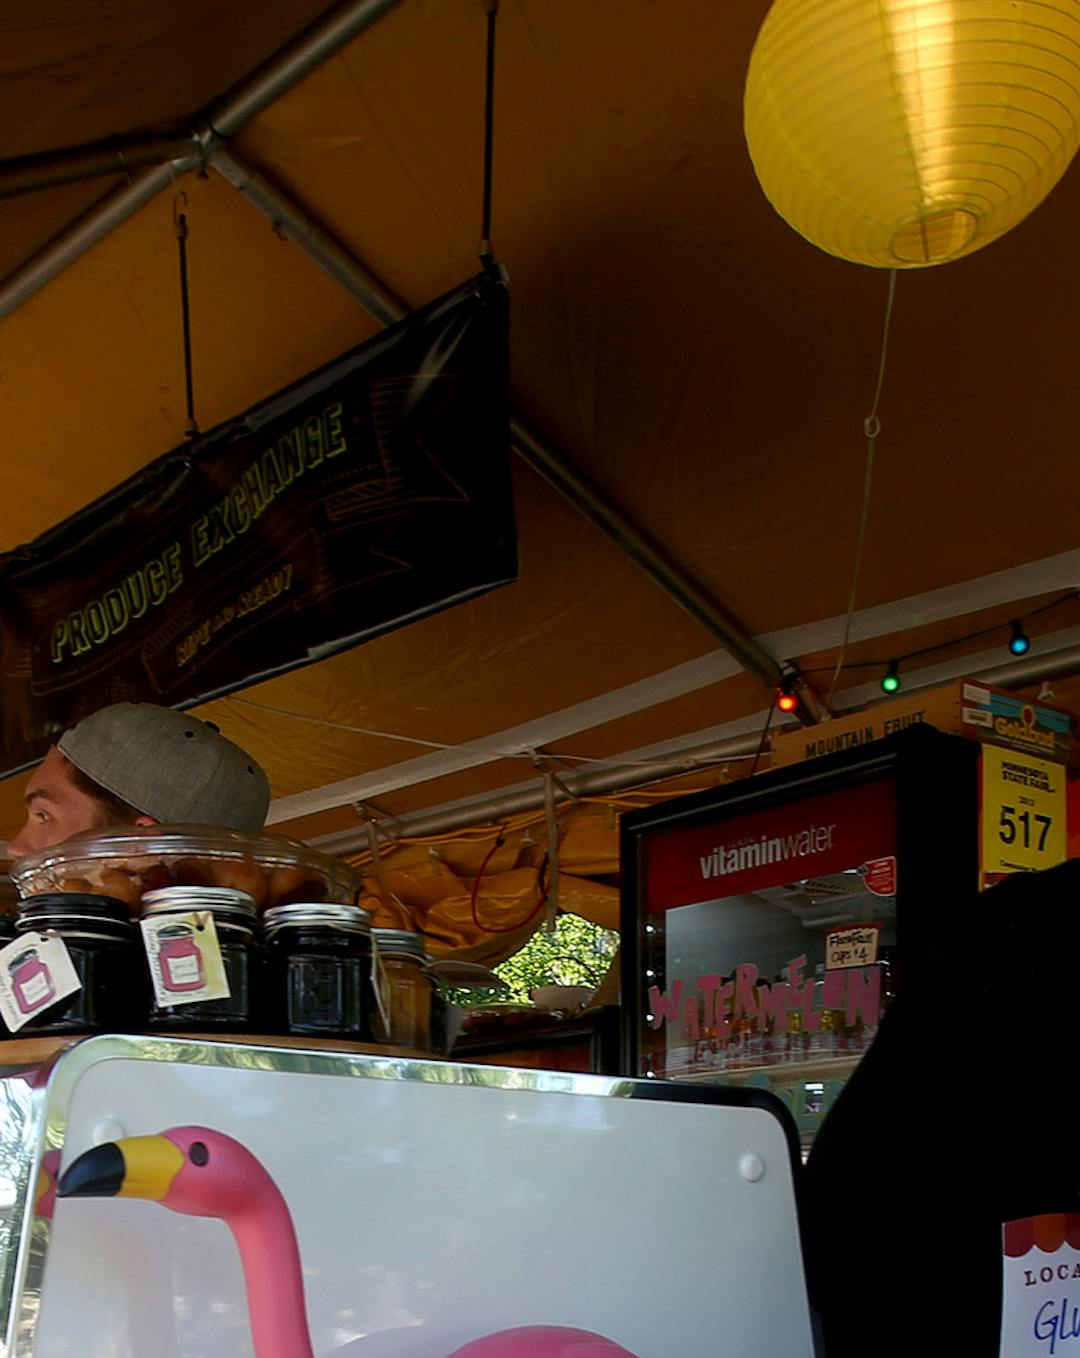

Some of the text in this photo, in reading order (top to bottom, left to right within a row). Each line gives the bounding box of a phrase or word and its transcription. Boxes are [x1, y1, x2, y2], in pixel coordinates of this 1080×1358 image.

[50, 401, 348, 664] PRODUCE EXCHANGE
[804, 711, 926, 759] MOUNTAIN FRUIT
[1002, 771, 1029, 786] STATE
[698, 824, 838, 880] vitaminwater
[998, 805, 1052, 852] 517
[648, 953, 882, 1045] WATERMELON
